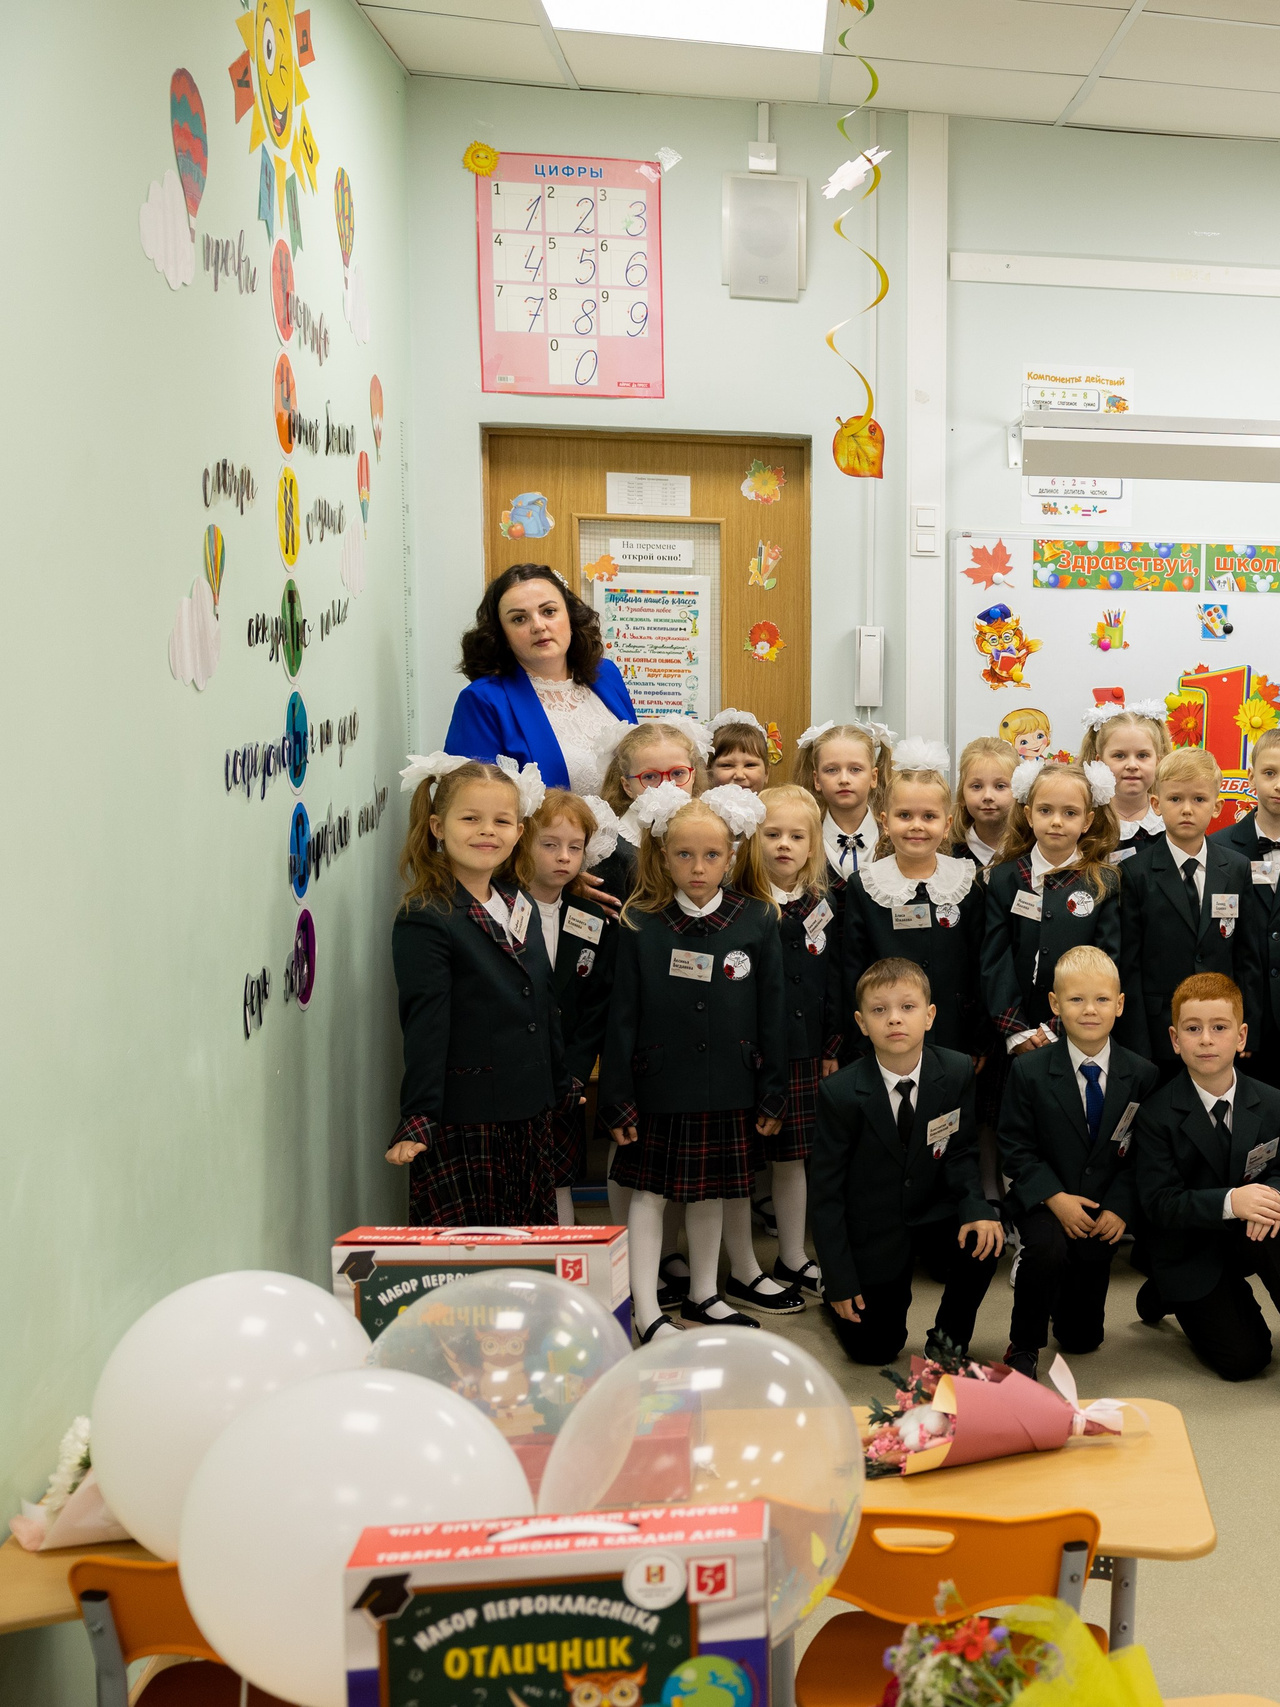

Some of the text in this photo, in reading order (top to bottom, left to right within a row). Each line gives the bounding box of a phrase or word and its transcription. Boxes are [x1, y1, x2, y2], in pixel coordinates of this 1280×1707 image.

[534, 163, 603, 179] ЦИФРЫ
[493, 183, 501, 196] 1
[547, 186, 555, 199] 2
[599, 189, 607, 202] 3
[526, 195, 542, 231] 1
[574, 197, 595, 234] 2
[626, 201, 647, 237] 3
[494, 233, 503, 246] 4
[548, 237, 556, 249] 5
[600, 239, 608, 252] 6
[524, 245, 543, 282] 4
[575, 249, 596, 285] 5
[625, 251, 648, 287] 6
[495, 285, 503, 298] 7
[549, 288, 558, 301] 8
[601, 290, 609, 303] 9
[524, 296, 544, 332] 7
[574, 299, 597, 335] 8
[626, 301, 648, 337] 9
[550, 338, 559, 351] 0
[575, 349, 598, 386] 0
[1027, 371, 1125, 386] Компоненты действий
[1061, 391, 1066, 399] 2
[1051, 478, 1097, 487] 6 2 3
[622, 541, 677, 551] На перемене
[621, 553, 682, 562] открой окно!
[1057, 549, 1200, 577] Здравствуй,
[609, 594, 697, 606] Правила нашего класса
[1178, 664, 1252, 770] 1
[564, 1262, 582, 1281] 5+
[377, 1278, 418, 1306] НАБОР
[376, 1526, 737, 1564] ТОВАРЫ ДЛЯ ШКОЛЫ НА КАЖДЫЙ ДЕНЬ
[413, 1594, 662, 1652] НАБОР ПЕРВОКЛАССНИКА
[443, 1635, 634, 1680] ОТЛИЧНИК
